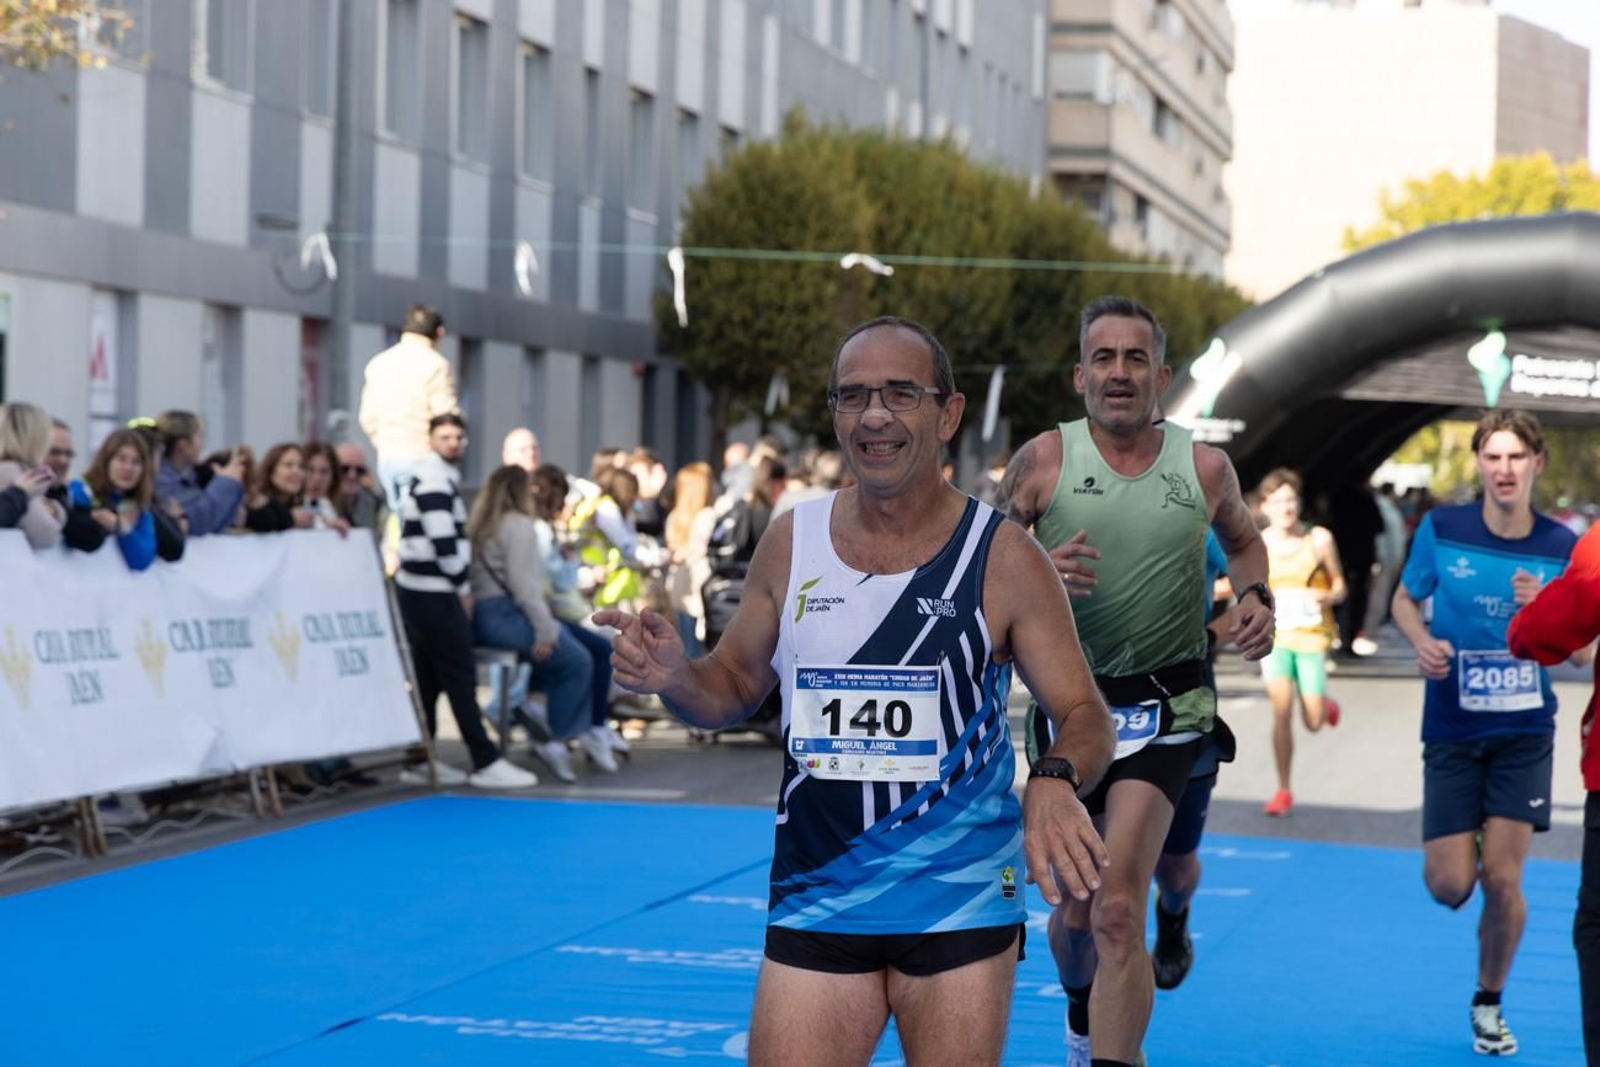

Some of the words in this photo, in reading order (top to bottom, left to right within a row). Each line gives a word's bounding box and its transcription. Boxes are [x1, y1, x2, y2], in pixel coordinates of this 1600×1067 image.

[806, 597, 845, 605] DIPUTACIÓN
[933, 599, 955, 609] RUN
[815, 603, 831, 612] JAÉN
[935, 607, 957, 617] PRO
[1467, 665, 1534, 690] 2085
[822, 698, 913, 738] 140
[831, 740, 866, 749] MIGUEL
